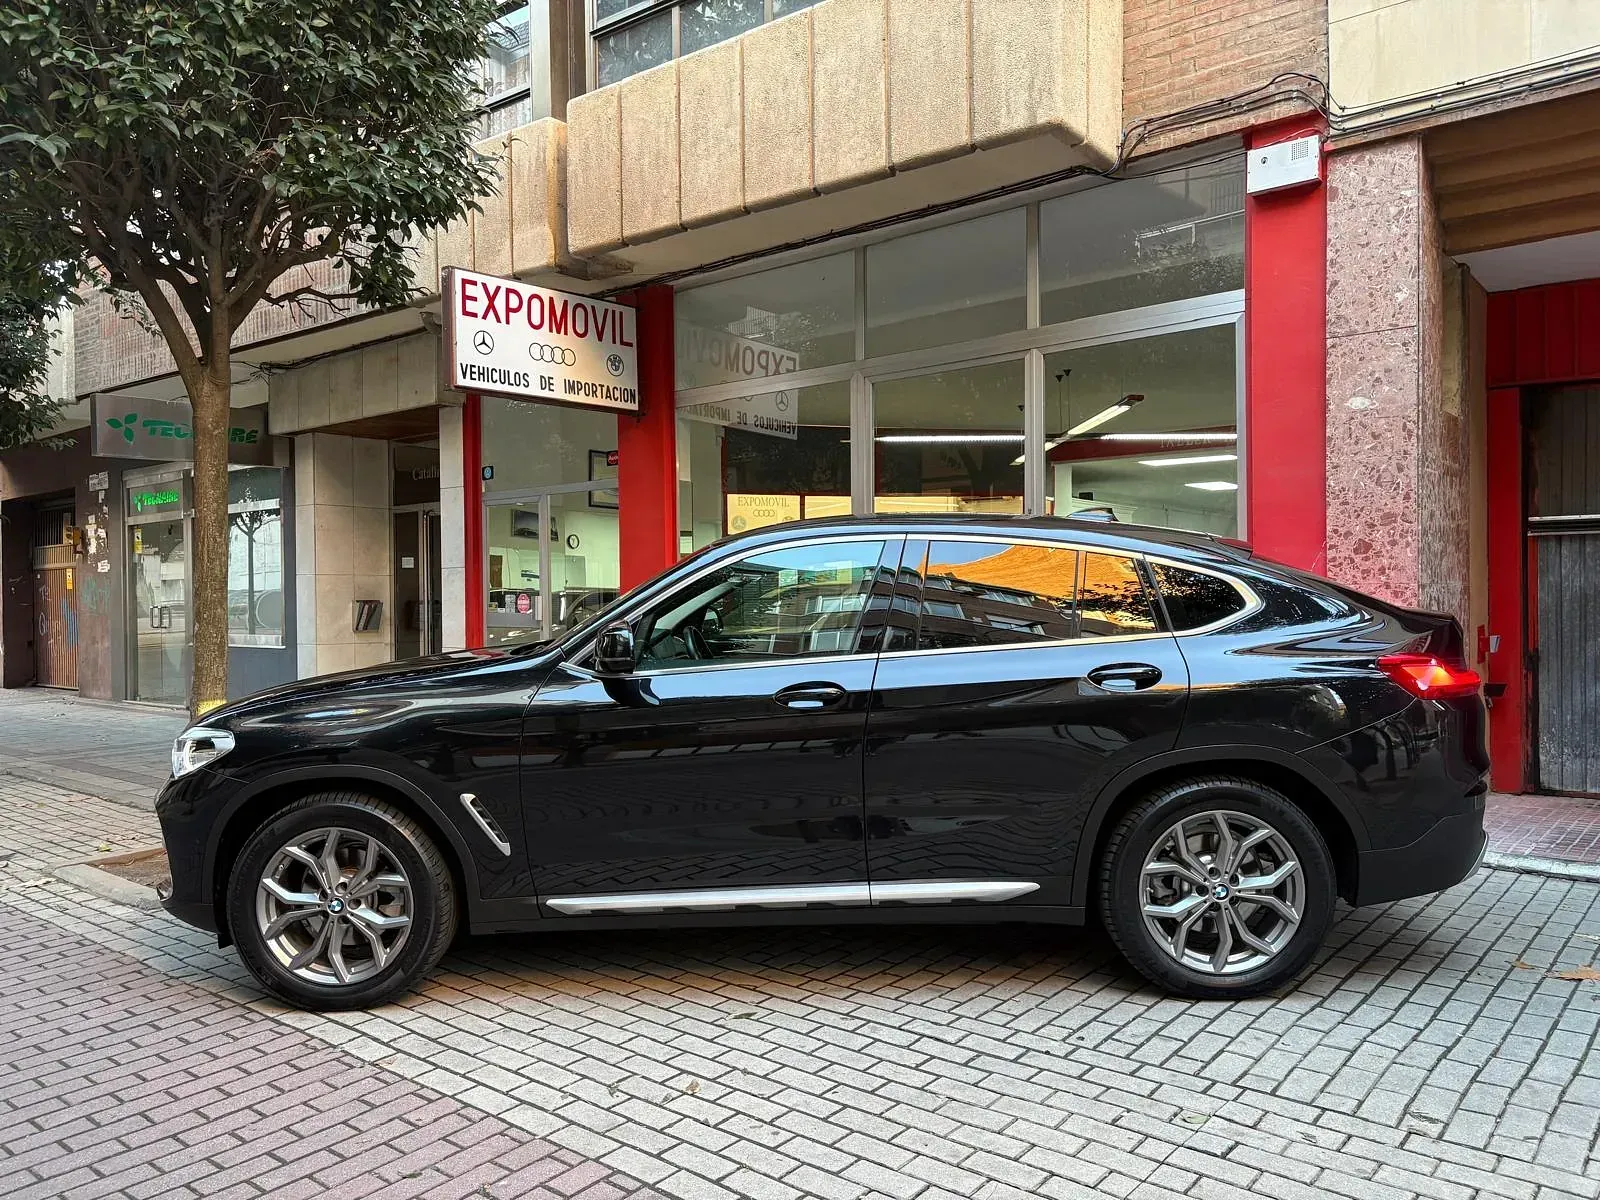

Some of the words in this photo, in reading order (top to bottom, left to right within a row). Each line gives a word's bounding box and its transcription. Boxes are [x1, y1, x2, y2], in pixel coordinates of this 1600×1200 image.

[461, 278, 634, 348] EXPOMOVIL
[460, 363, 530, 388] VEHICULOS
[540, 374, 555, 393] DE
[563, 378, 637, 405] IMPORTACION
[737, 496, 790, 508] EXPOMOVIL
